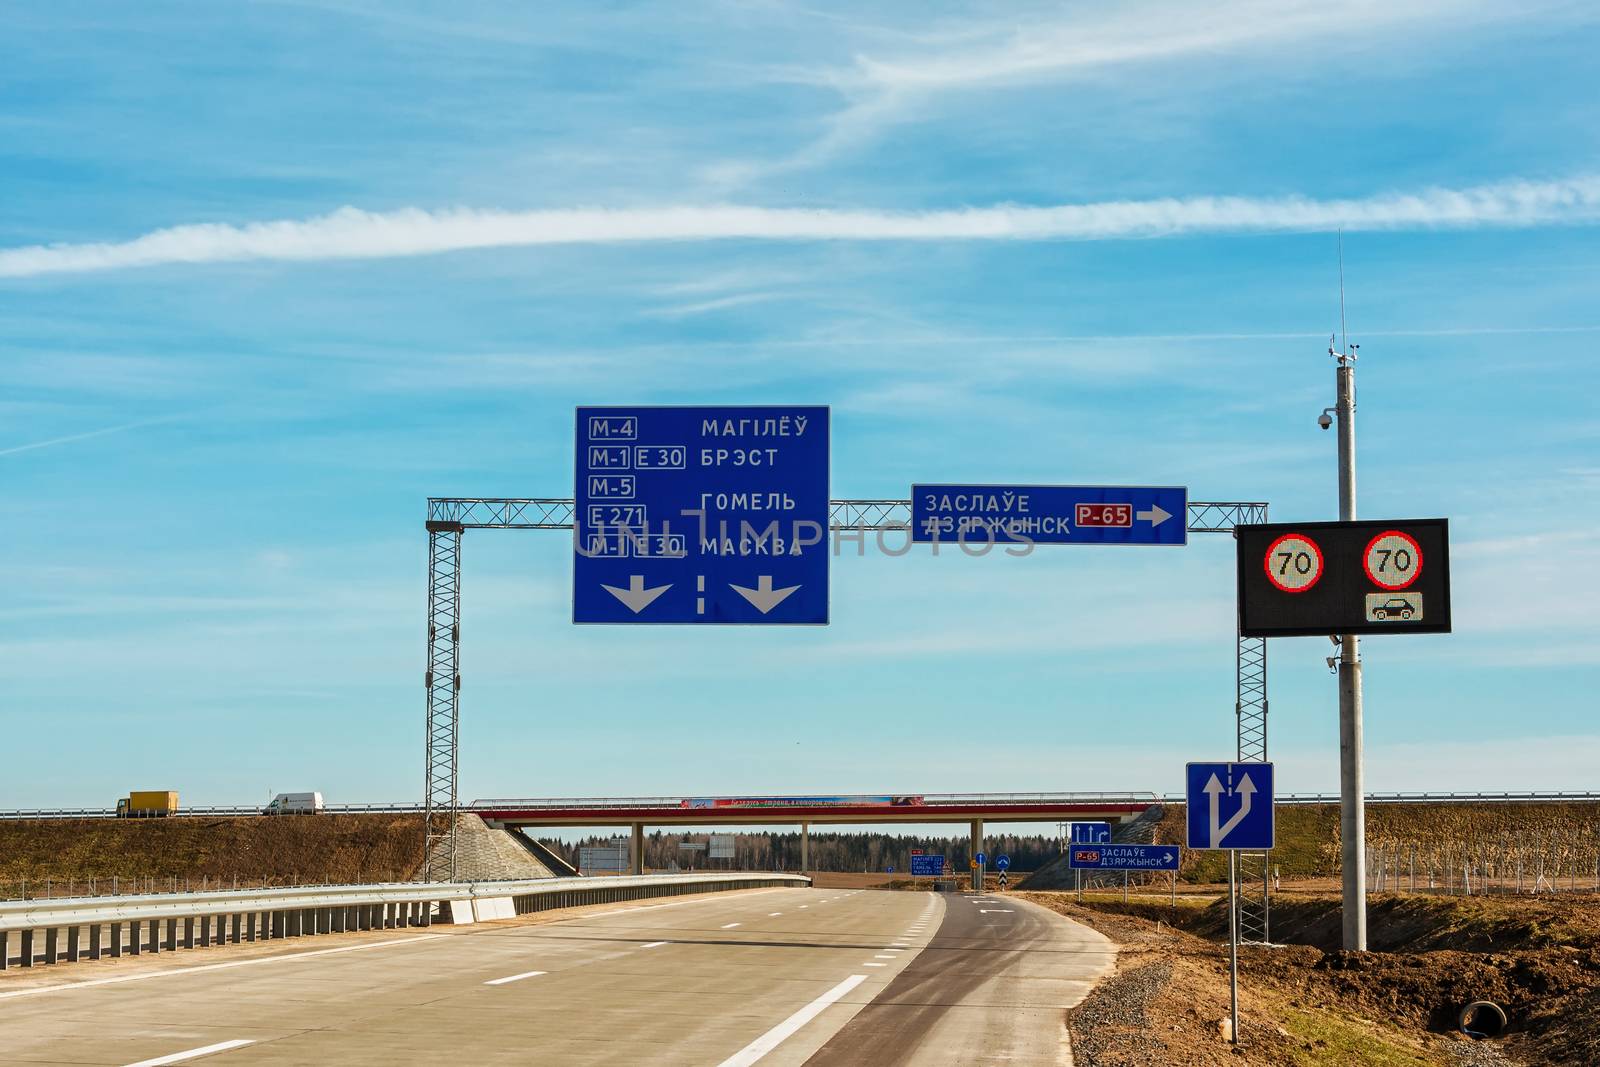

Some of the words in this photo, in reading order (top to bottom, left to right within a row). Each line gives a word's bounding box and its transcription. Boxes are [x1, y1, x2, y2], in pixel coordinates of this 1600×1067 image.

[592, 419, 634, 437] М-4
[701, 415, 808, 437] МАГІЛЁЎ
[592, 449, 628, 466] М-1
[657, 449, 683, 466] 30
[700, 449, 778, 466] БРЭСТ
[591, 478, 632, 495] М-5
[700, 493, 796, 510] ГОМЕЛЬ
[924, 491, 1030, 512] ЗАСЛАЎЕ
[610, 508, 643, 525] 271
[1078, 506, 1128, 524] Р-65
[924, 516, 1071, 536] ДЗЯРЖЫНСК
[655, 538, 681, 555] 30
[700, 538, 804, 555] МАСКВА
[1276, 552, 1312, 575] 70
[1376, 549, 1411, 572] 70
[1076, 851, 1098, 861] Р-65
[1100, 847, 1145, 857] ЗАСЛАЎЕ
[1100, 858, 1163, 867] ДЗЯРЖЫНСК
